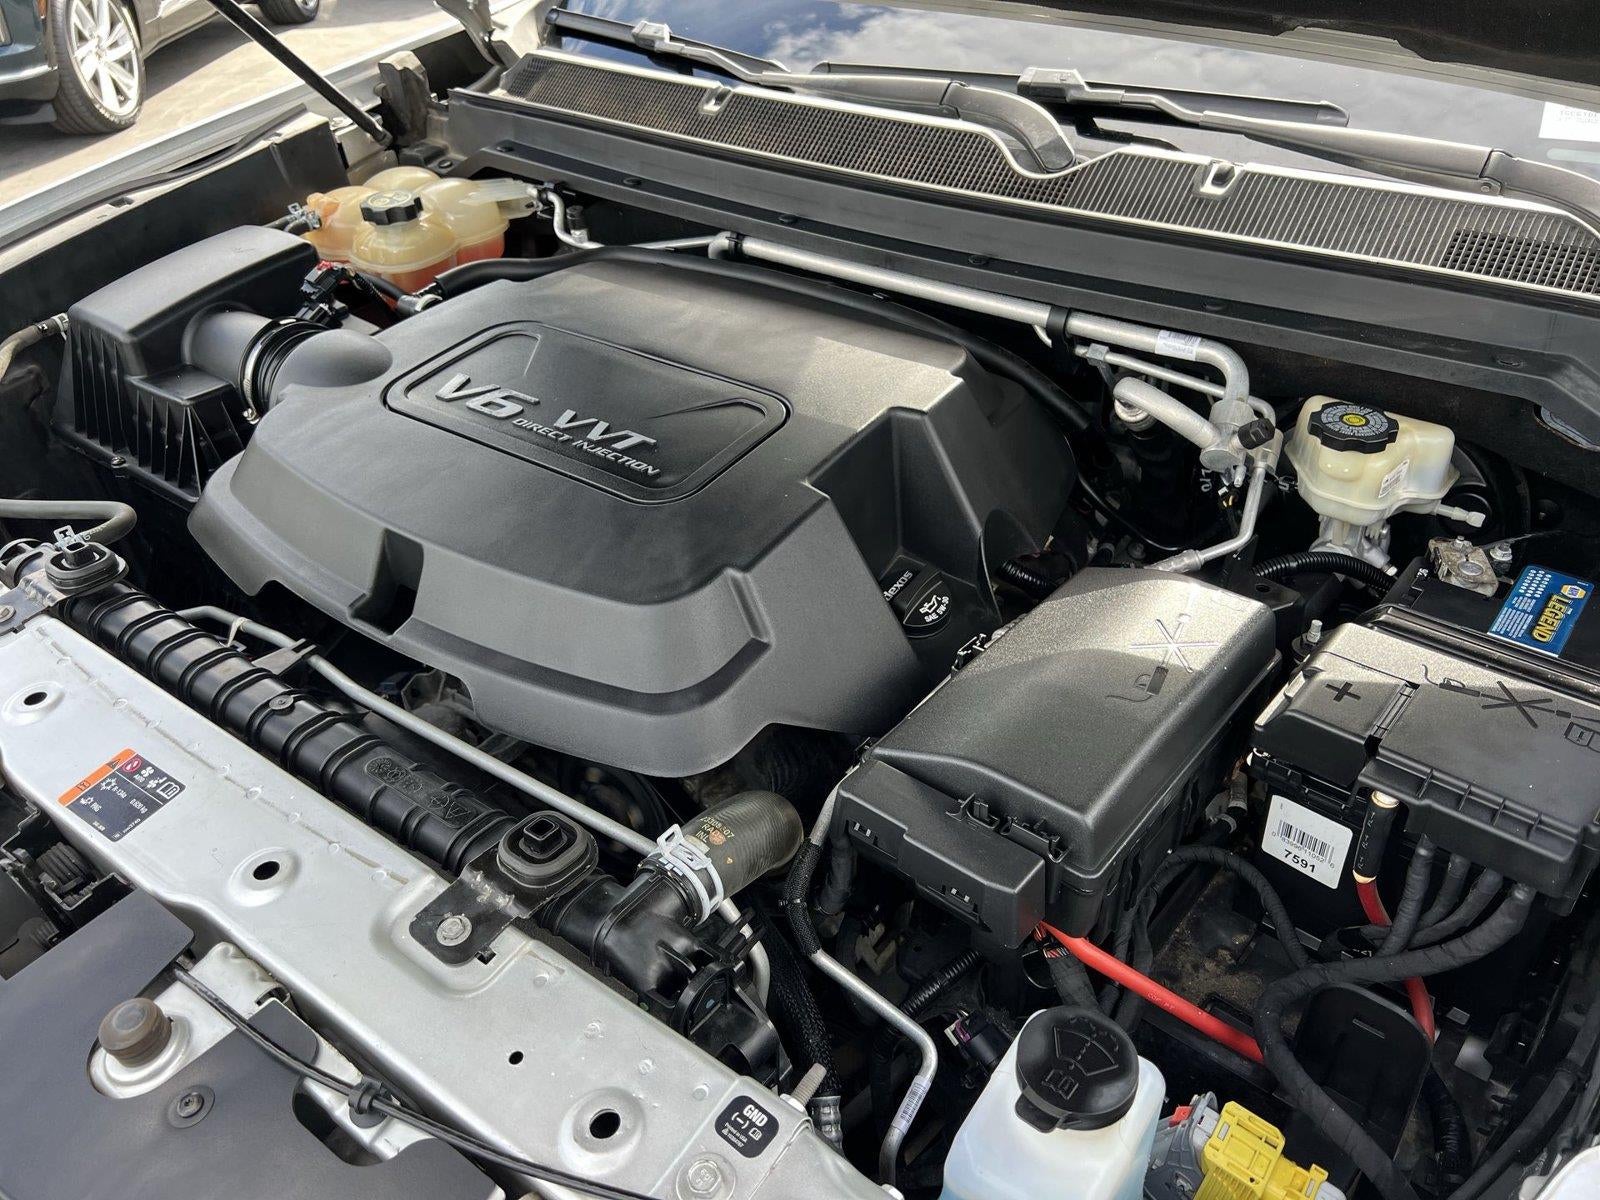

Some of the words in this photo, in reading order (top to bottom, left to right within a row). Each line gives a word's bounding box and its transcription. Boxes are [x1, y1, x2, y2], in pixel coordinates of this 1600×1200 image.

[435, 373, 540, 419] V6
[553, 408, 657, 450] VVT
[512, 417, 573, 442] DIRECT
[572, 439, 662, 477] INJECTION
[883, 570, 913, 601] dexos
[924, 612, 939, 623] SAE
[1532, 594, 1572, 643] LEGEND
[1283, 848, 1316, 873] 7591
[743, 1104, 768, 1127] GND
